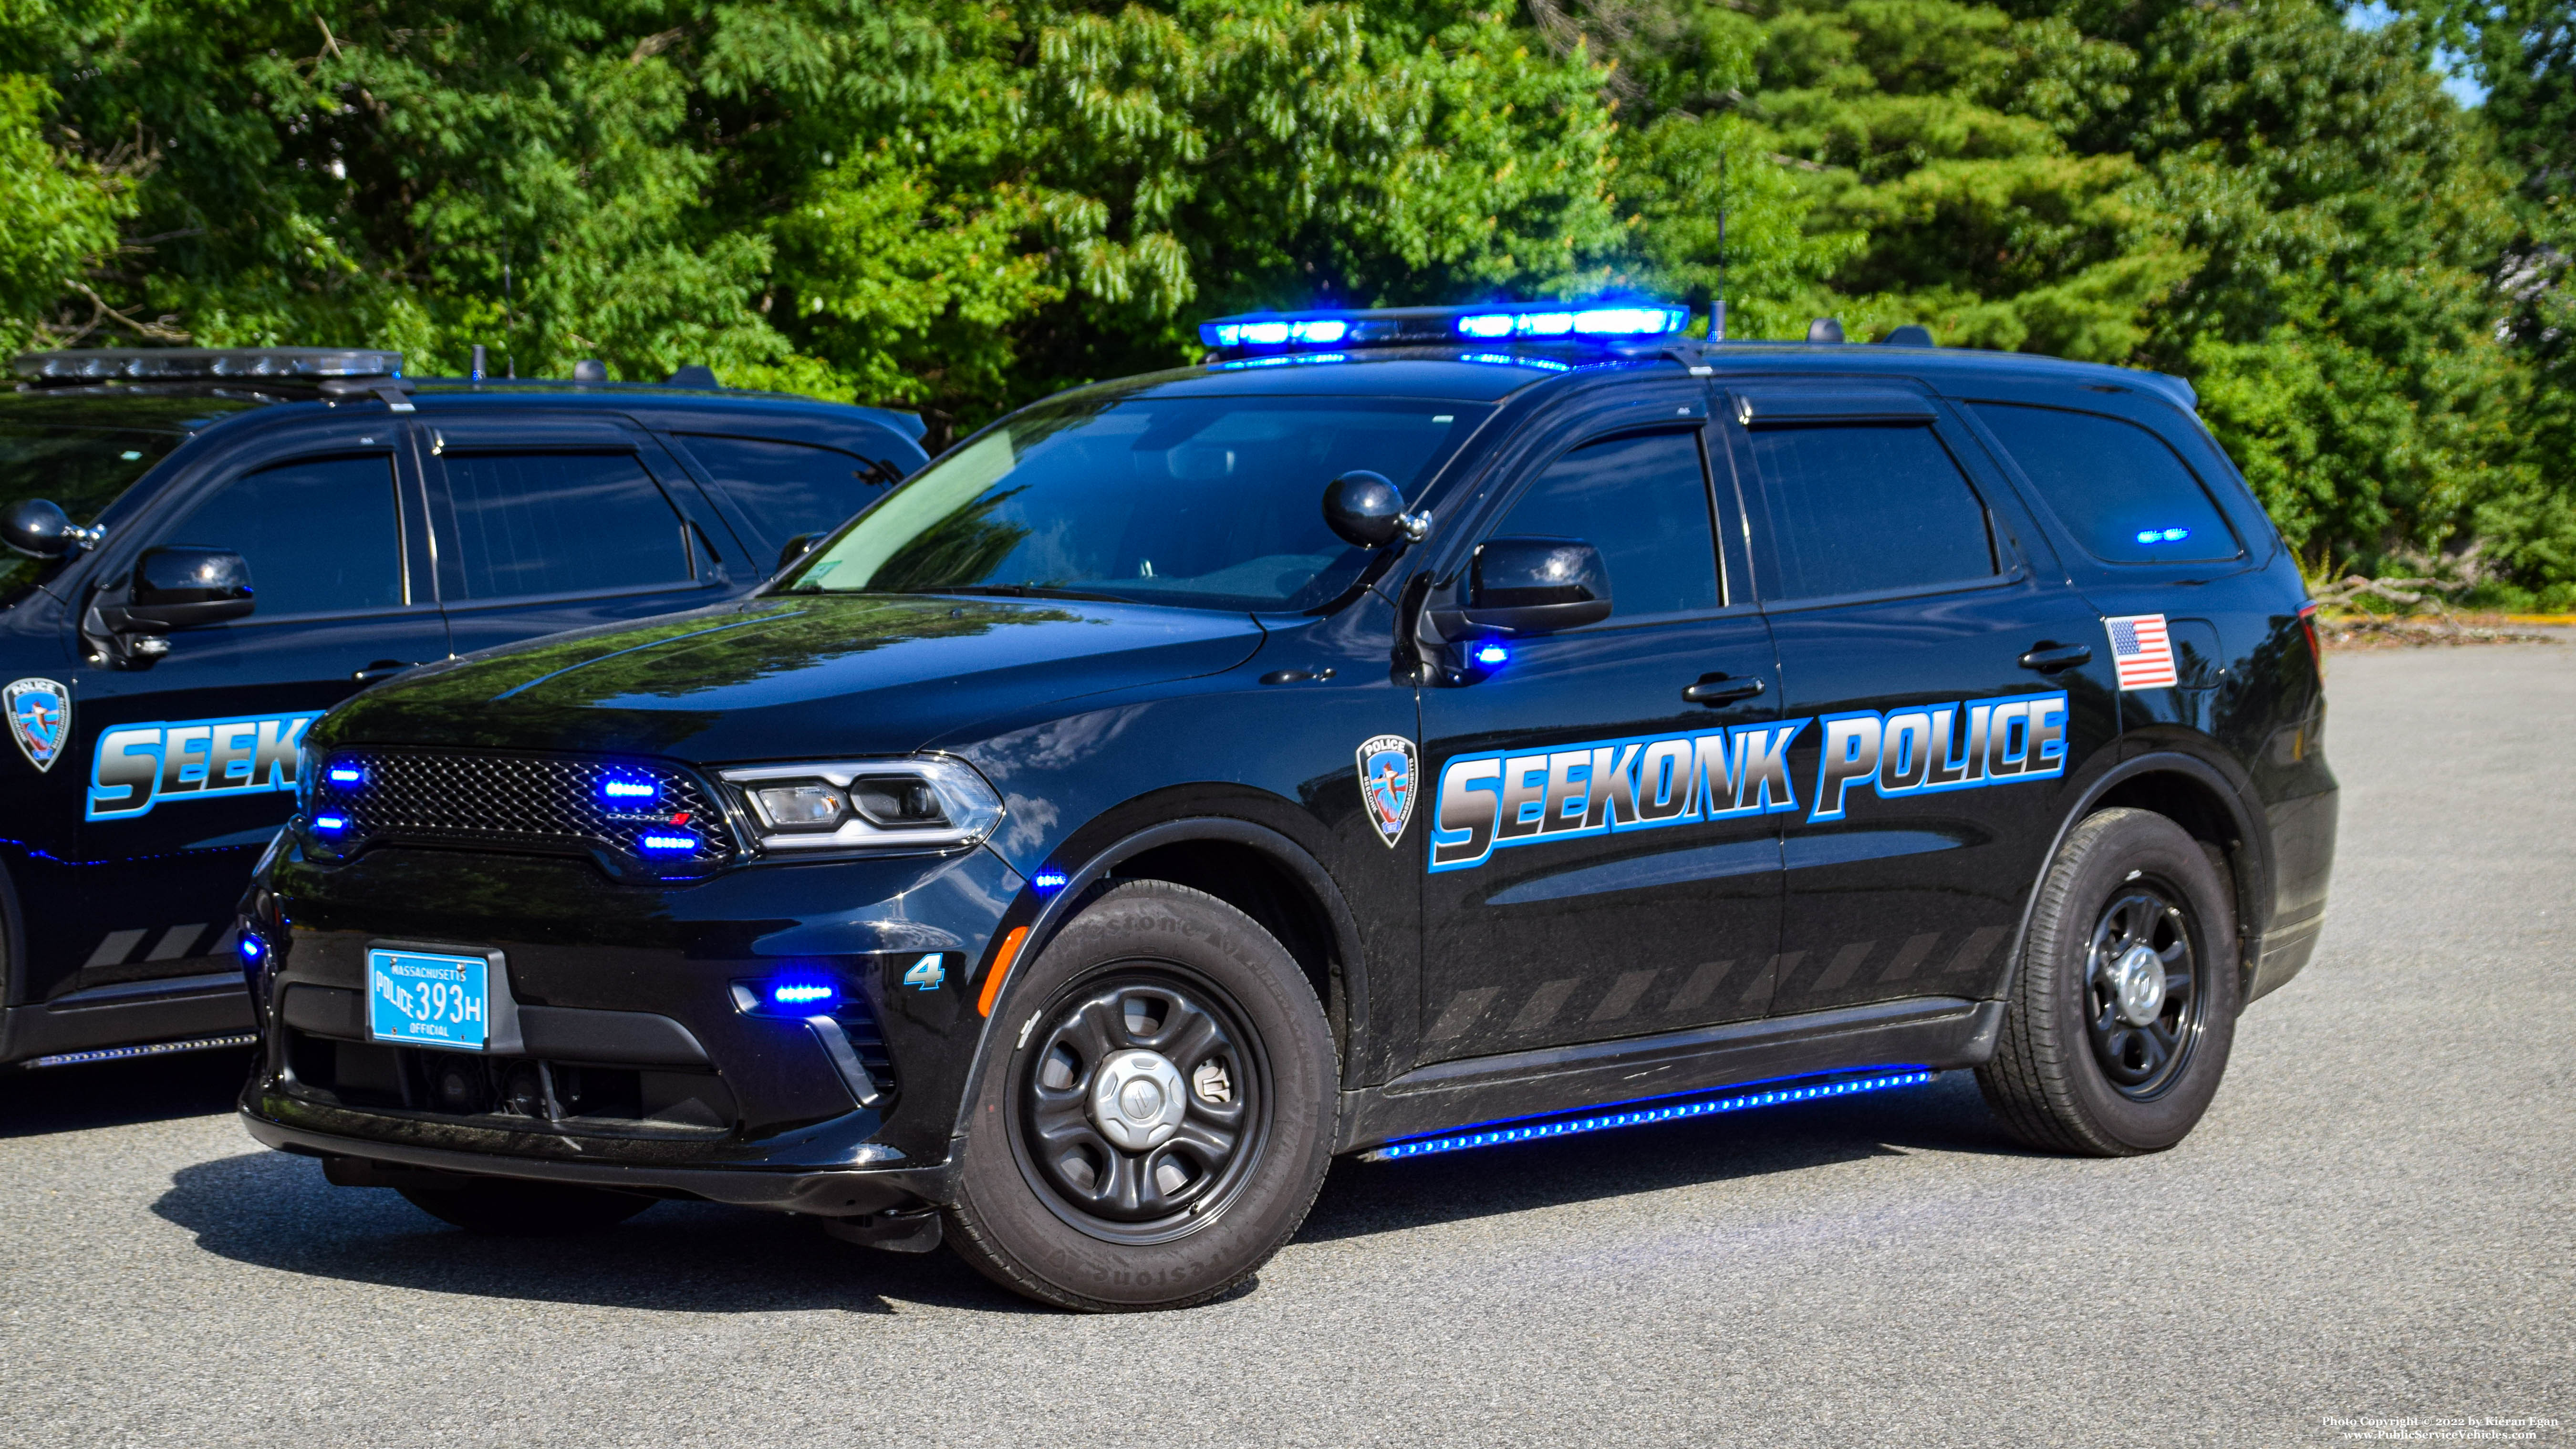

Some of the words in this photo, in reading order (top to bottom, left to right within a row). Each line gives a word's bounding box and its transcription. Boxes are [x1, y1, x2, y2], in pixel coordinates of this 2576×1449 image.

[11, 681, 56, 695] POLICE
[1364, 738, 1406, 757] POLICE
[1363, 776, 1378, 813] SEEKONK
[1400, 757, 1413, 821] MASSACHUSETTS
[1428, 717, 1813, 873] SEEKONK
[1807, 690, 2068, 823] POLICE
[606, 812, 679, 822] DODGE
[392, 965, 467, 982] MASSACHUSETTS
[904, 952, 945, 991] 4
[376, 970, 414, 1018] POLICE
[415, 982, 481, 1024] 393H
[409, 1022, 449, 1037] OFFICIAL
